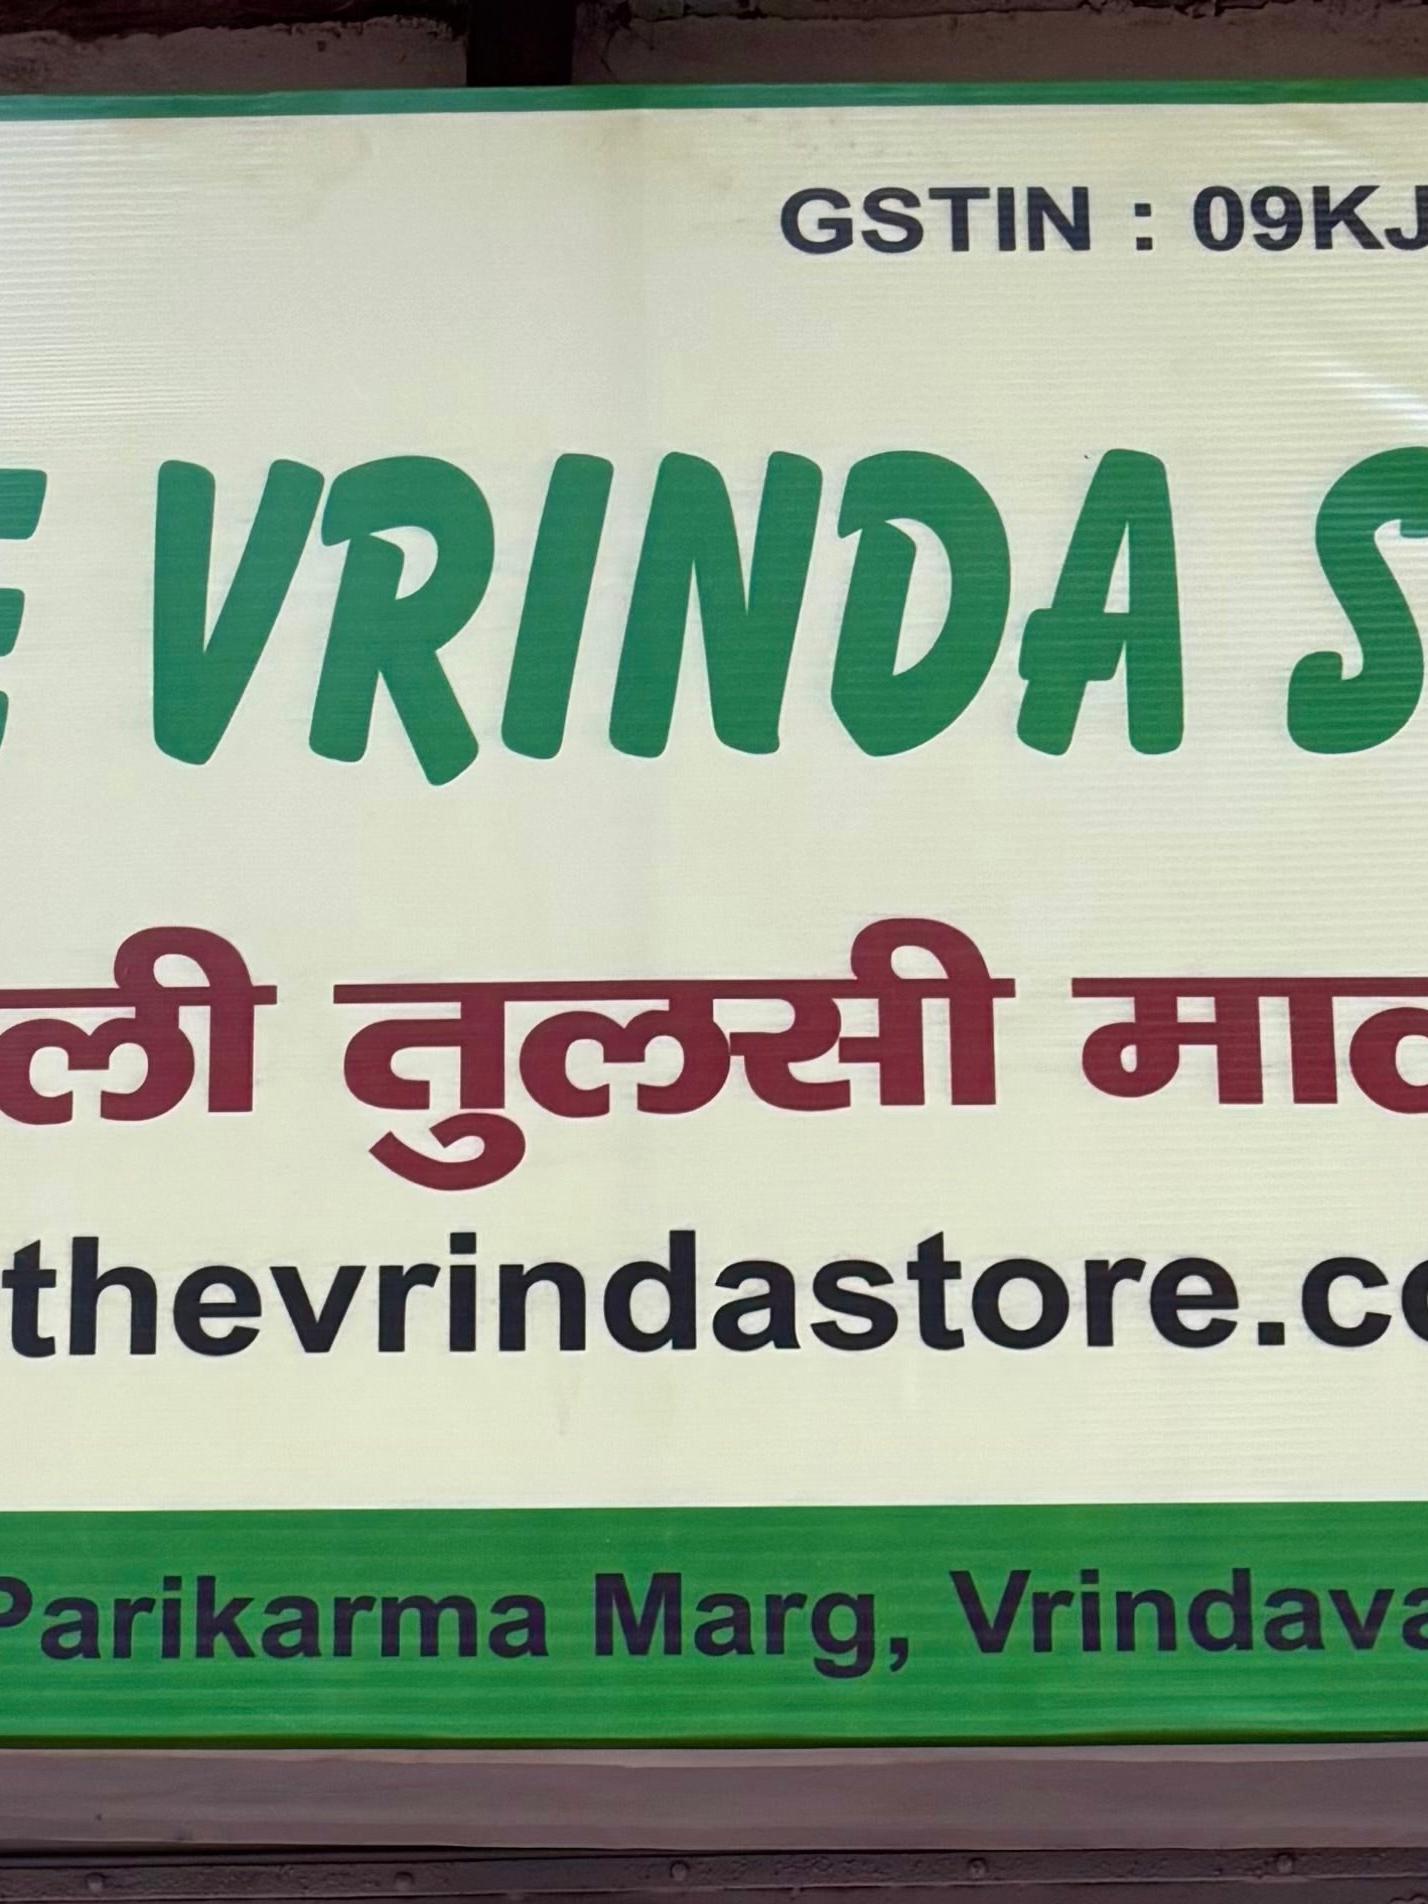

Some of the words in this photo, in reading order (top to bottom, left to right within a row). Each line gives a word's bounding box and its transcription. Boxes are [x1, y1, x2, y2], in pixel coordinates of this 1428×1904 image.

[781, 187, 1090, 254] GSTIN
[153, 449, 1184, 785] VRINDA
[334, 918, 1015, 1191] तुलसी
[594, 1574, 907, 1679] Marg,
